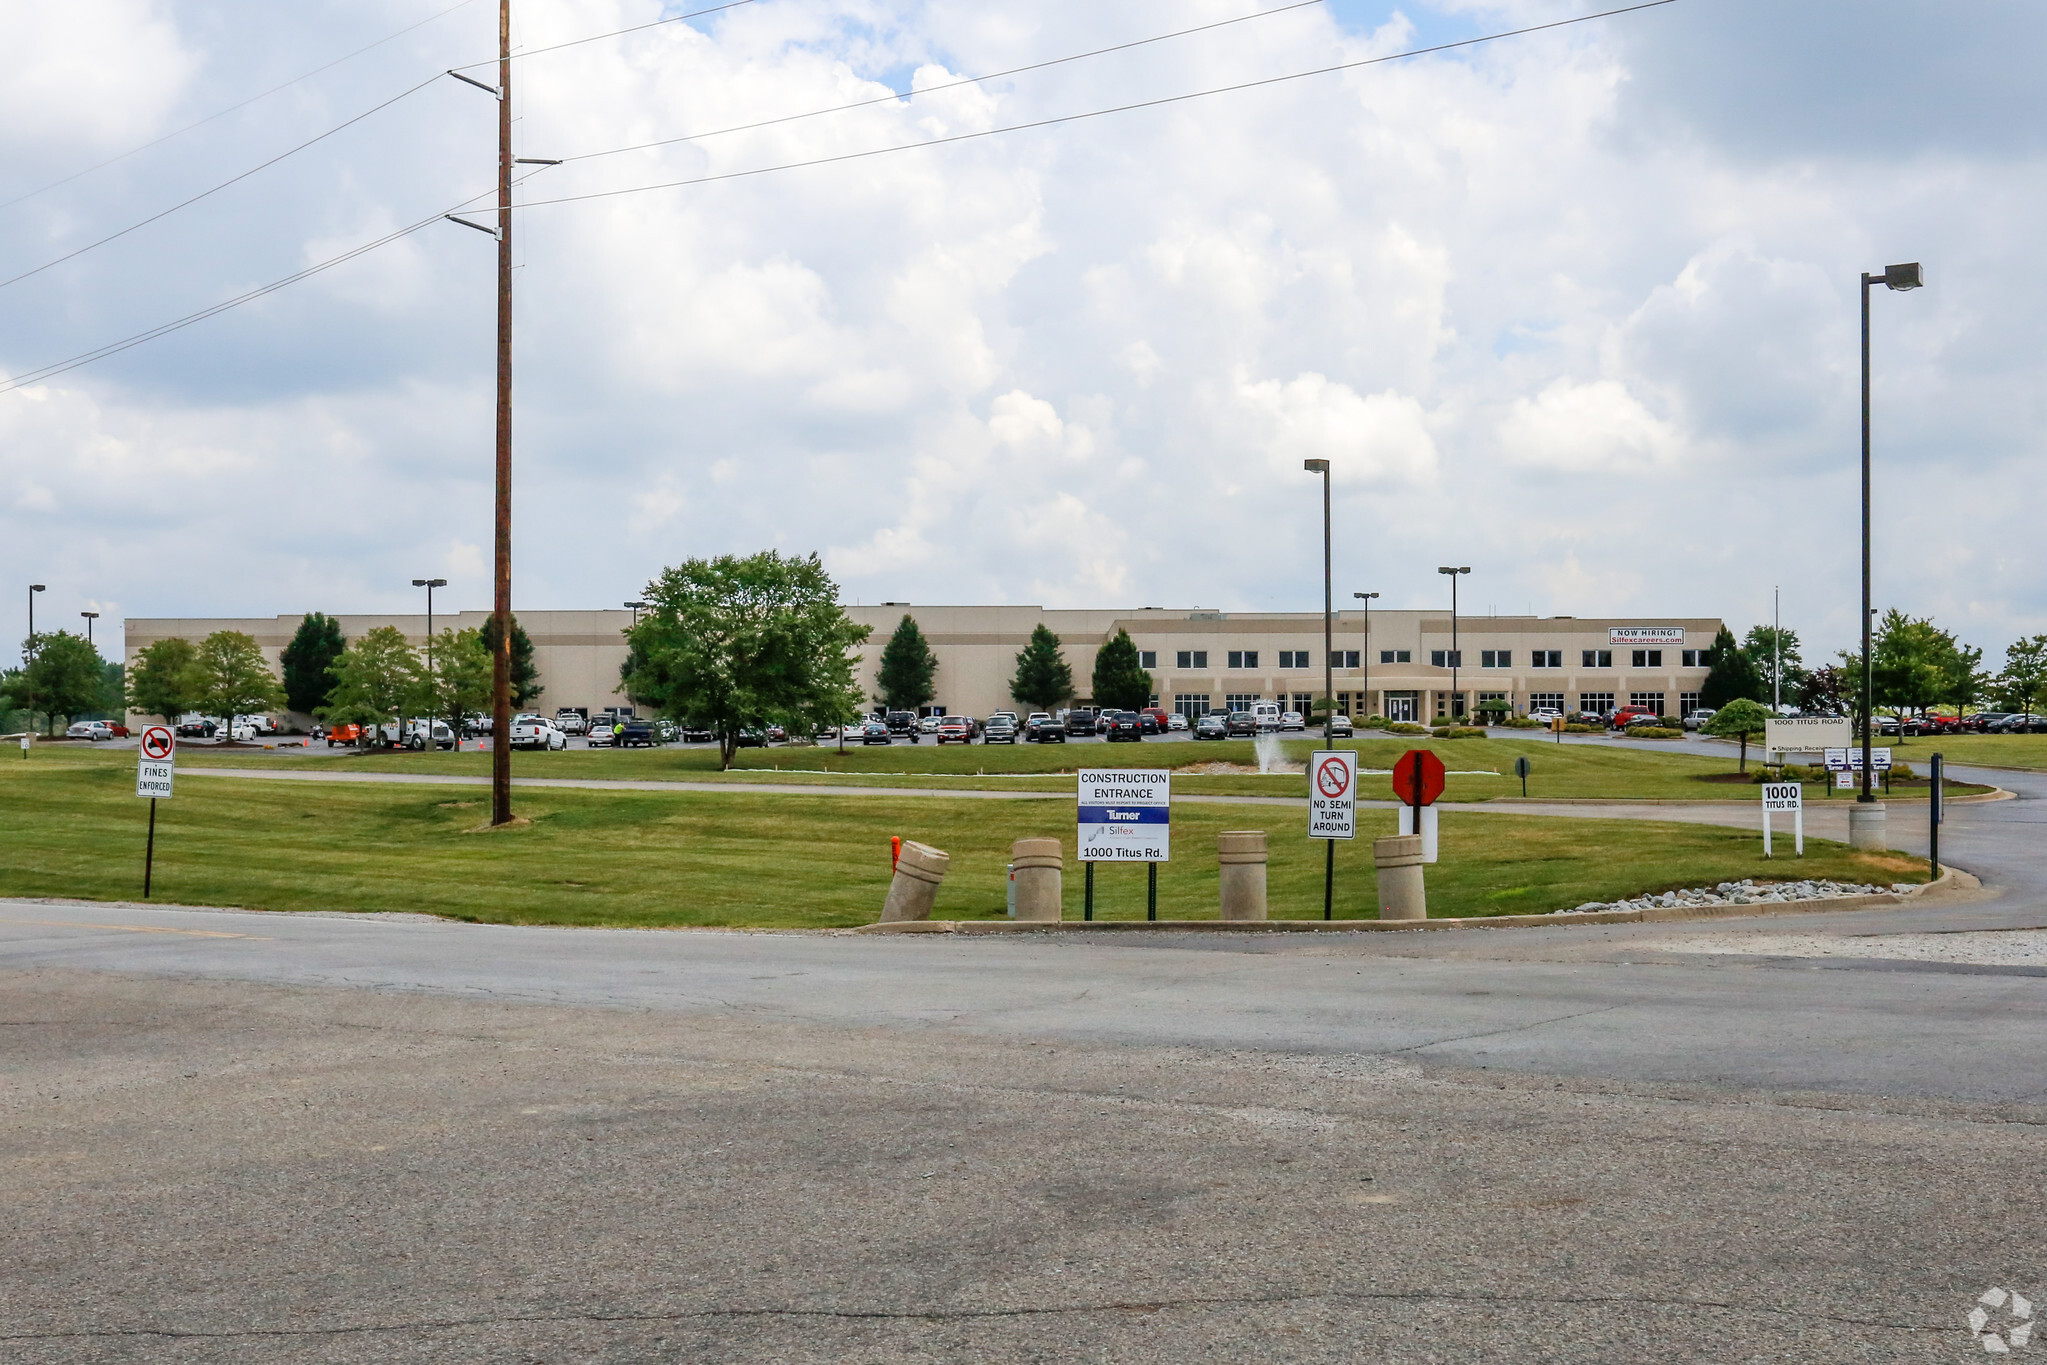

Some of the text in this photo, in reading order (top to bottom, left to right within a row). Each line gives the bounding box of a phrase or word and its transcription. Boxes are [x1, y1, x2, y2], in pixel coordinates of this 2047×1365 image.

[144, 768, 168, 777] FINES
[1082, 774, 1166, 783] CONSTRUCTION
[140, 781, 170, 791] ENFORCED
[1094, 789, 1153, 798] ENTRANCE
[1766, 786, 1797, 799] 1000
[1106, 810, 1140, 820] Turner
[1109, 826, 1134, 835] Silfex
[1313, 823, 1350, 831] AROUND
[1084, 848, 1162, 857] 1000 Titus Rd.
